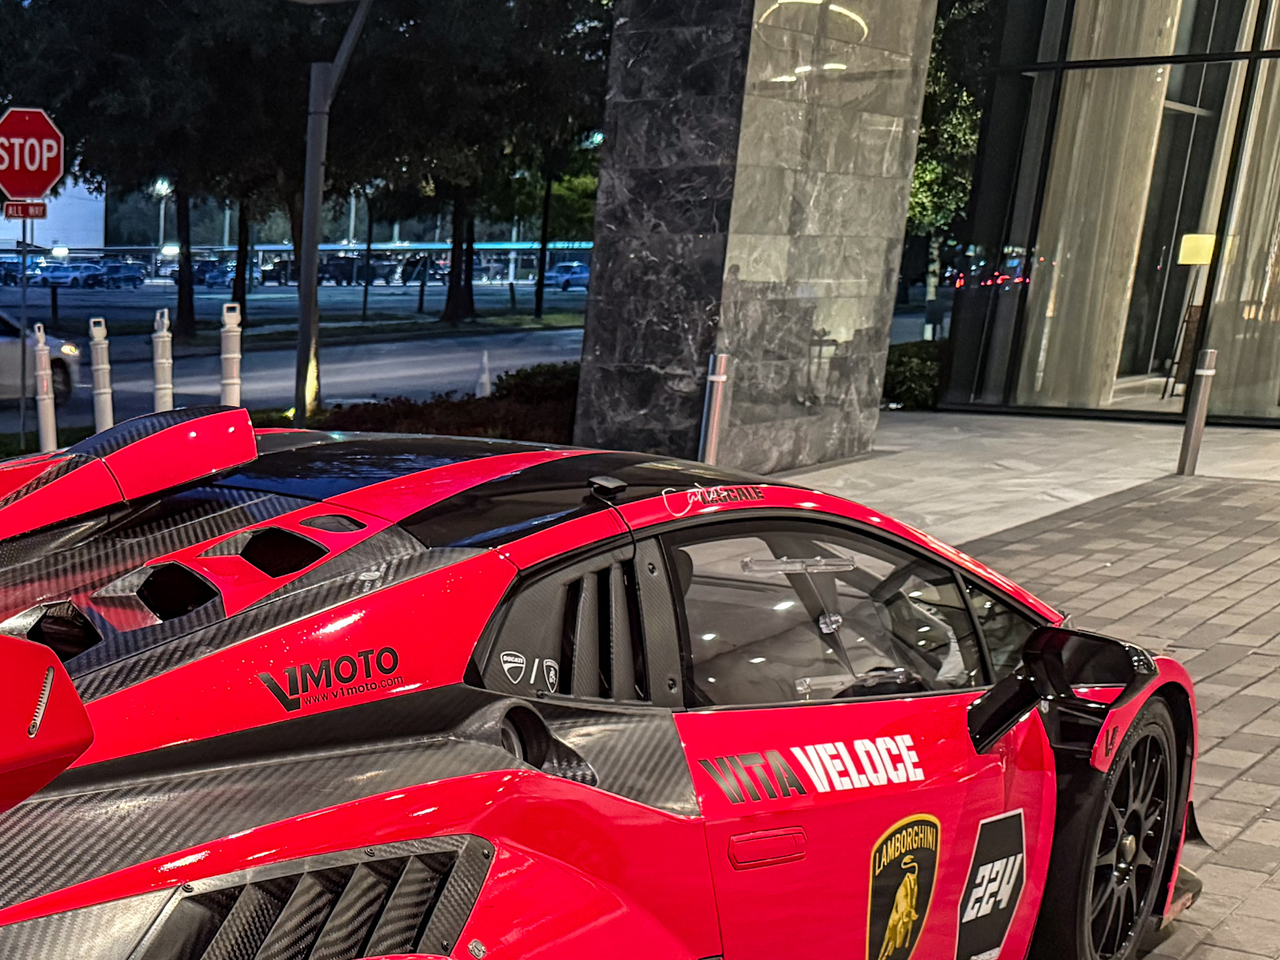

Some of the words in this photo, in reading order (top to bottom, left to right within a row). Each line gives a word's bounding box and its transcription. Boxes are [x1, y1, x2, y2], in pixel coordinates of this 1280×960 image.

[7, 205, 24, 217] ALL
[28, 205, 44, 217] WAY
[698, 750, 807, 804] VITA
[790, 733, 925, 793] VELOCE
[875, 825, 936, 876] LAMBORGHINI
[961, 852, 1023, 924] 224
